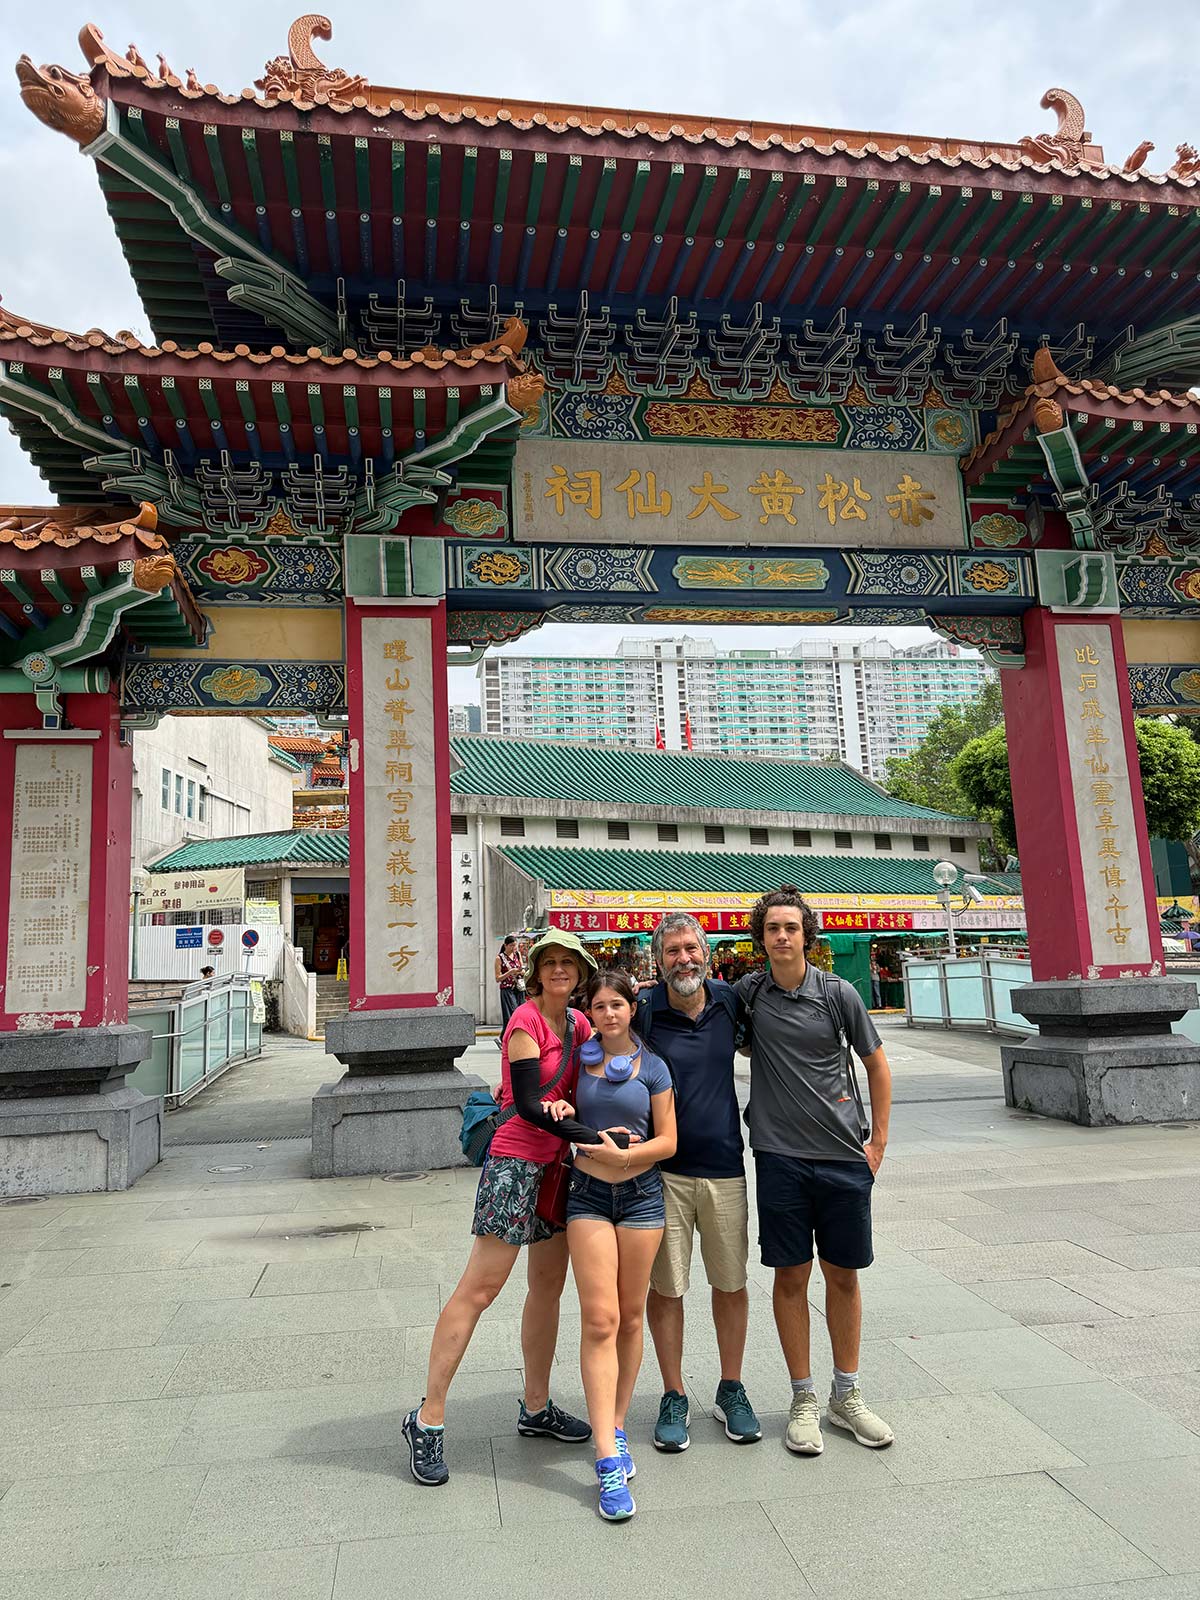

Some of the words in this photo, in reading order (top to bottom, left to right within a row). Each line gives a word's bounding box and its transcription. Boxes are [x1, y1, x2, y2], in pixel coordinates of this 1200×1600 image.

[462, 874, 472, 936] 東華三院
[558, 913, 601, 929] 彭友記
